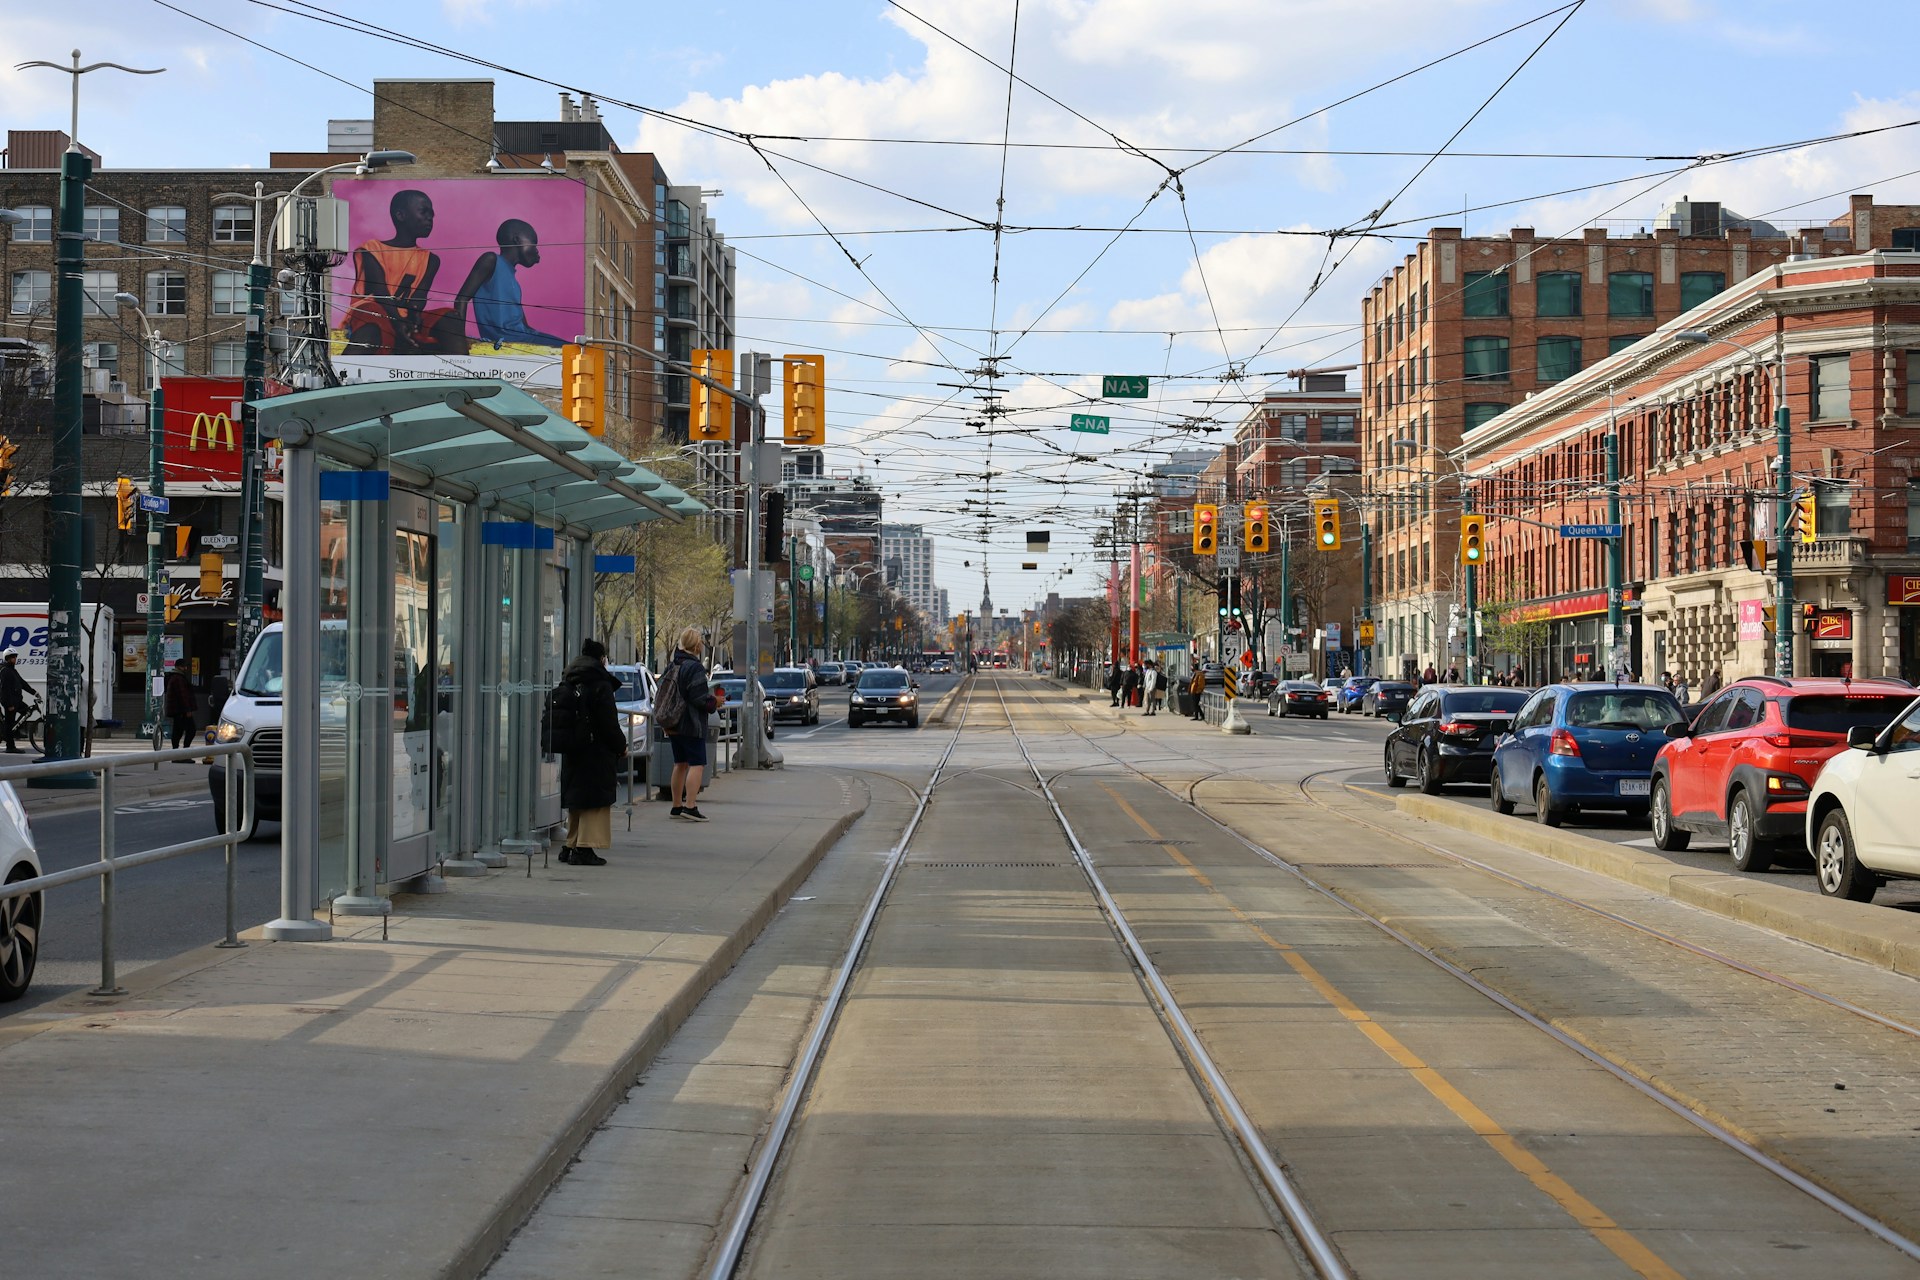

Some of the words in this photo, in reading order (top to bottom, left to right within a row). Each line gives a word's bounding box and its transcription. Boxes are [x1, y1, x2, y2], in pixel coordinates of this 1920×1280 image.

[389, 369, 414, 379] Shot
[416, 369, 435, 379] and
[438, 369, 470, 379] Edited
[473, 371, 486, 379] on
[489, 369, 526, 379] iPhone
[1105, 380, 1131, 394] NA
[1085, 418, 1107, 431] NA
[1568, 526, 1597, 535] Queen
[1605, 526, 1613, 534] W
[1219, 548, 1238, 556] TRANSIT
[1220, 557, 1237, 565] SIGNAL
[1746, 604, 1756, 616] Open
[1821, 615, 1842, 625] CIBC
[1823, 640, 1840, 648] 378
